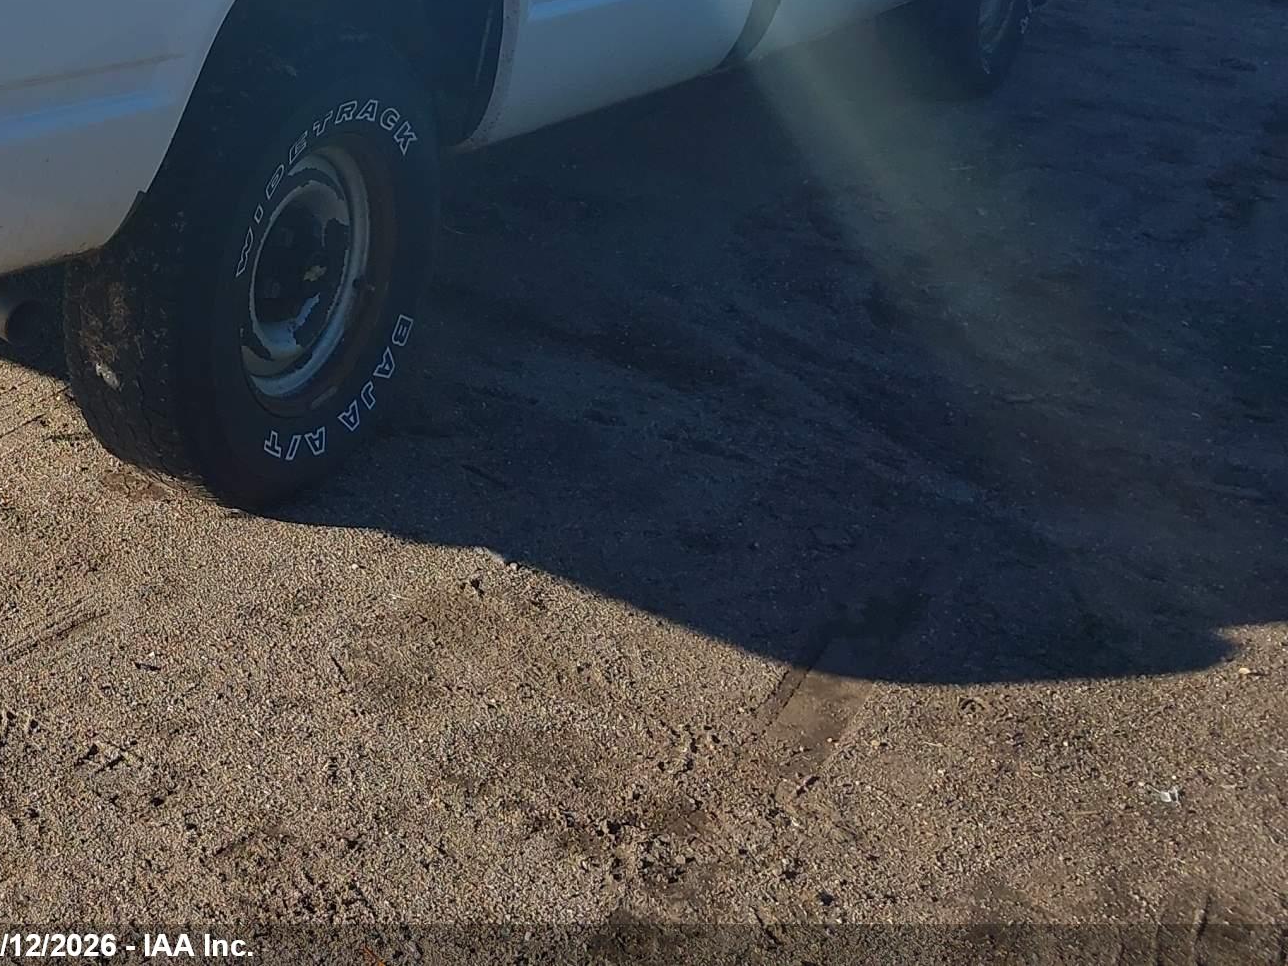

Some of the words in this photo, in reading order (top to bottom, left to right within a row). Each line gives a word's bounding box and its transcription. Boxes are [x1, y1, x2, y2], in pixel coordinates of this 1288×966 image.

[235, 99, 418, 278] WIDETRACK
[337, 314, 414, 432] BAJA
[263, 425, 328, 461] A/T
